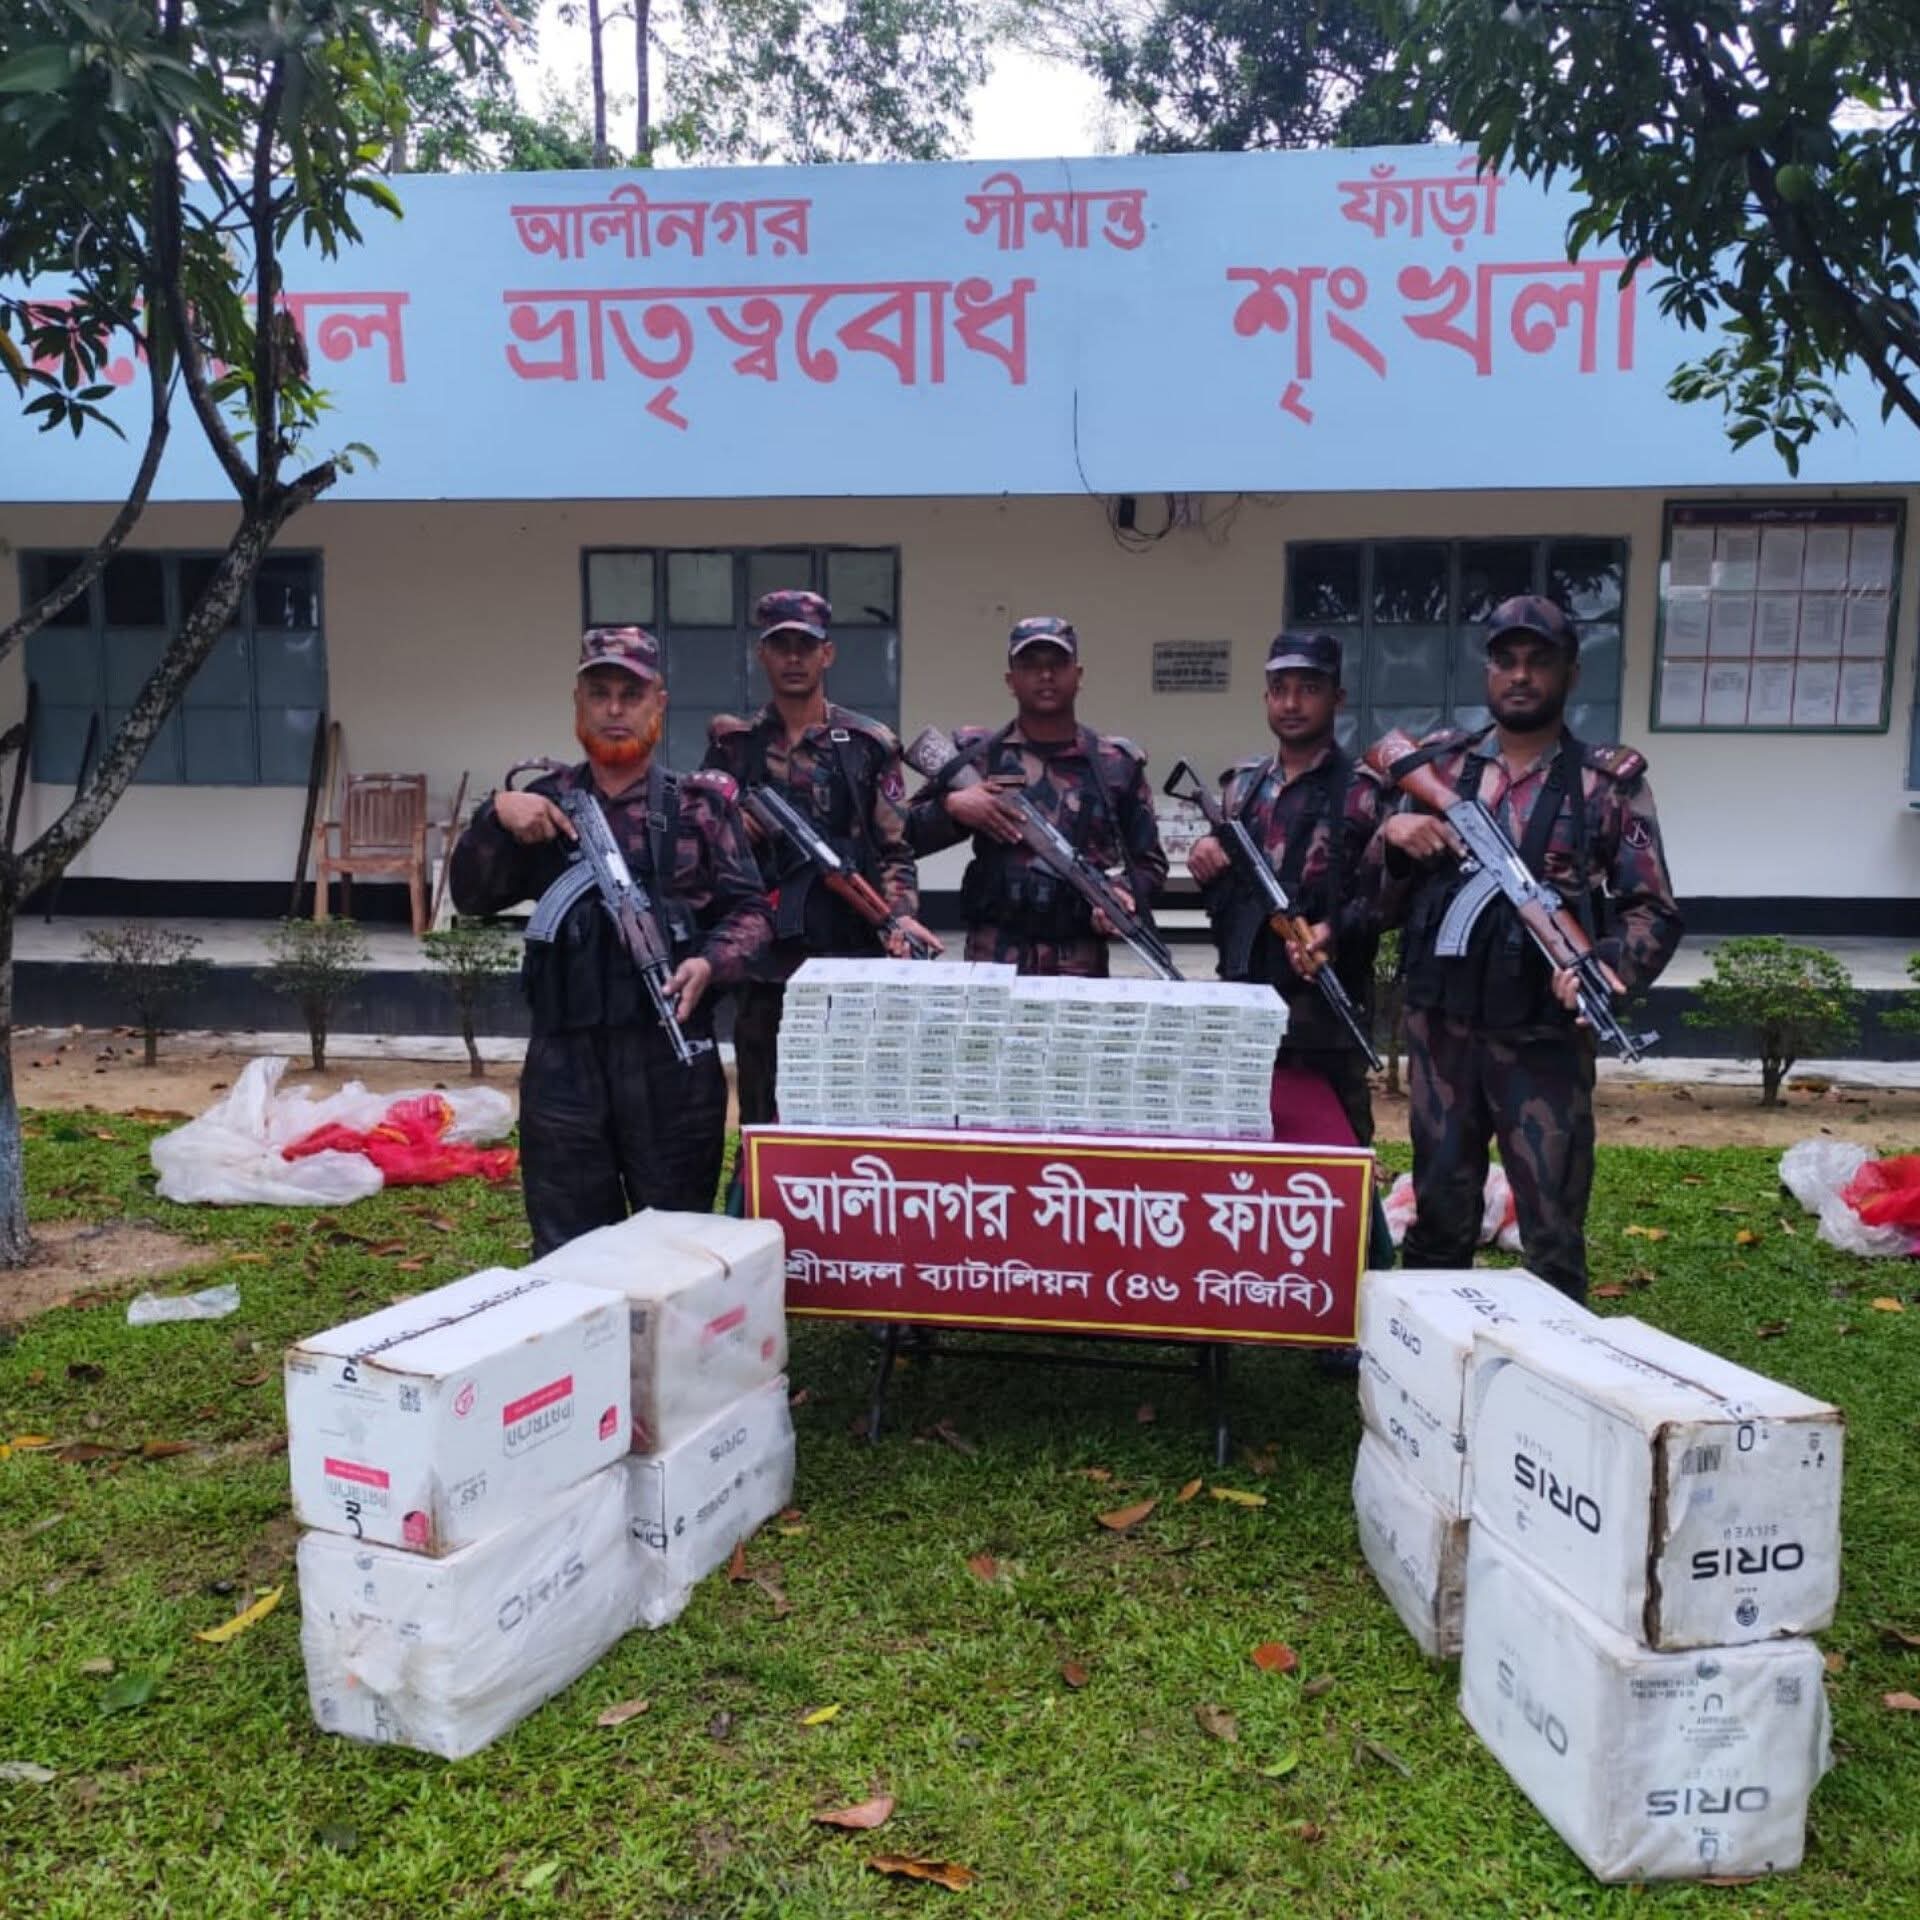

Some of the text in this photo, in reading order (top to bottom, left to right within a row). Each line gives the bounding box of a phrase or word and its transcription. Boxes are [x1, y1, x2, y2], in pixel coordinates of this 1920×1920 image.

[511, 155, 1505, 259] আলীনগর সীমান্ত ফাঁড়ী
[504, 276, 1035, 430] ভ্রাতৃত্ববোধ
[1227, 257, 1652, 424] শৃংখলা
[775, 1154, 1344, 1267] আলীনগর সীমান্ত ফাঁড়ী
[785, 1249, 1335, 1317] শ্রীমঙ্গল ব্যাটালিয়ন (৪৬ বিজিবি)
[1514, 1452, 1601, 1534] ORIS
[1692, 1542, 1804, 1580] ORIS
[1645, 1785, 1770, 1818] ORIS
